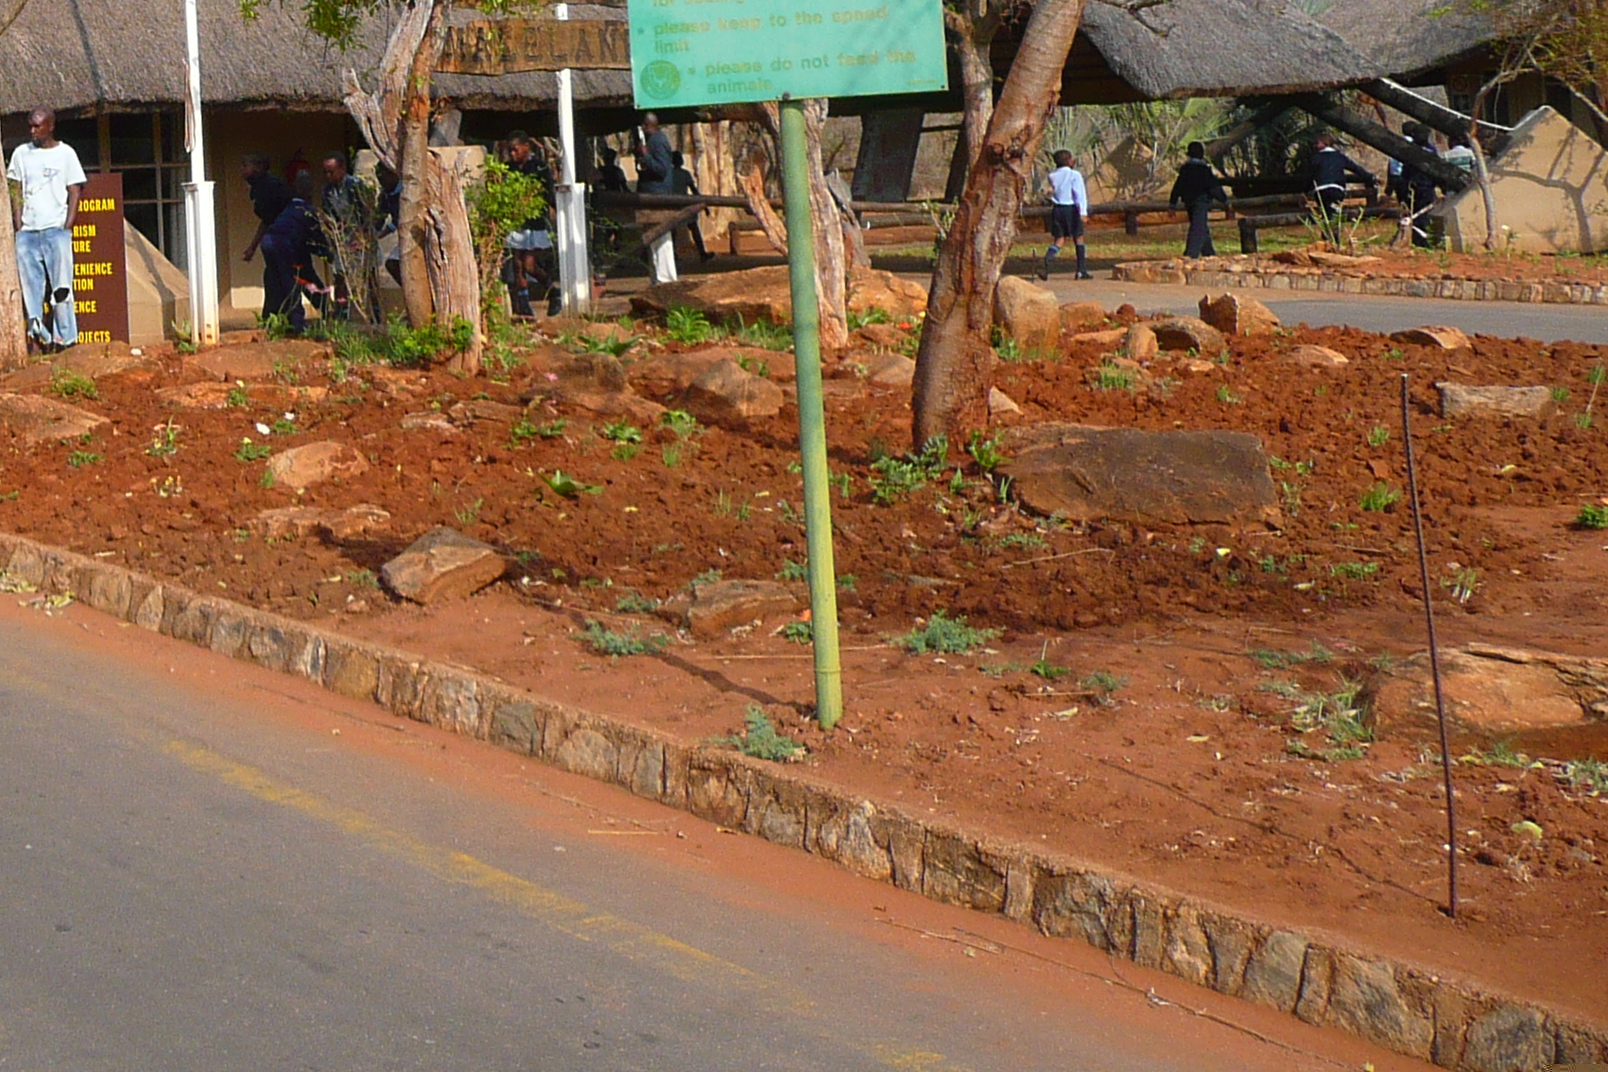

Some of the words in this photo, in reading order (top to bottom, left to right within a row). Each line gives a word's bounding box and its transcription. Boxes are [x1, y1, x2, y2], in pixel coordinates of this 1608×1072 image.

[654, 20, 710, 37] please
[718, 17, 762, 31] keep
[769, 13, 787, 27] to
[794, 11, 823, 25] the
[832, 5, 889, 24] speed
[655, 39, 690, 54] limit
[705, 60, 763, 77] please
[770, 57, 793, 71] do
[800, 54, 829, 70] not
[837, 50, 879, 66] feed
[886, 49, 916, 64] the
[707, 77, 772, 94] animals
